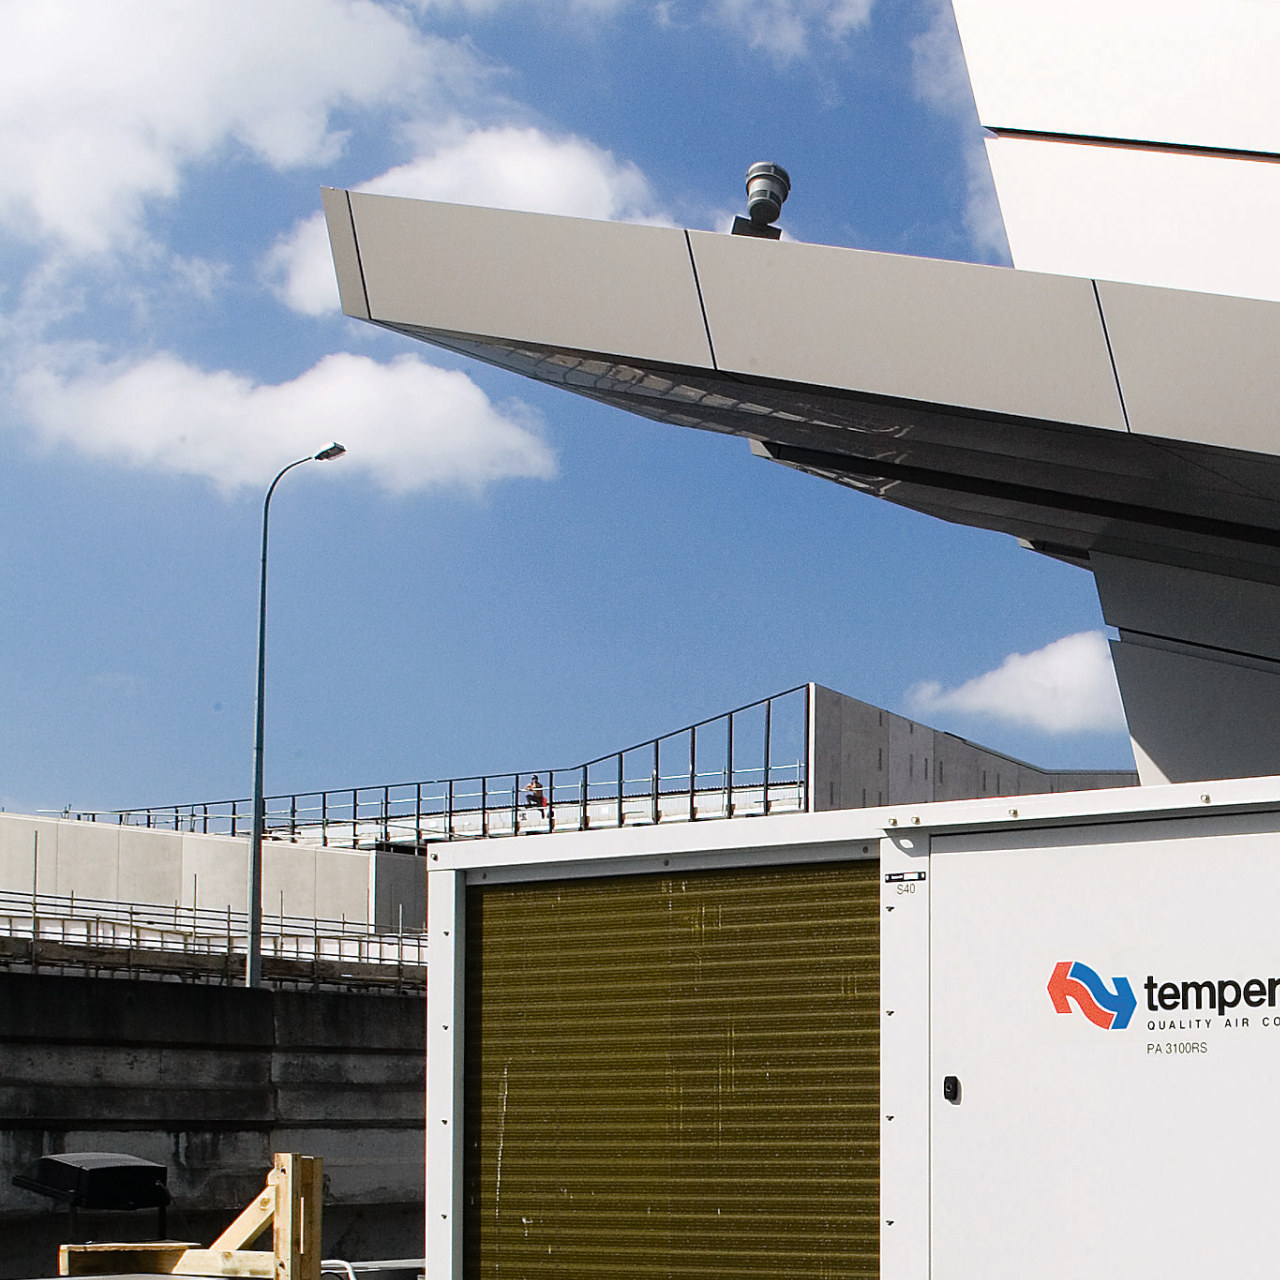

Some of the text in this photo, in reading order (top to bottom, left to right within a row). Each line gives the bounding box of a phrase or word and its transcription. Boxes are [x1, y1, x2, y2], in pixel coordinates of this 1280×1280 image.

[896, 883, 916, 895] S40
[1147, 1019, 1212, 1031] QUALITY
[1224, 1018, 1250, 1028] AIR
[1147, 1044, 1162, 1054] PA
